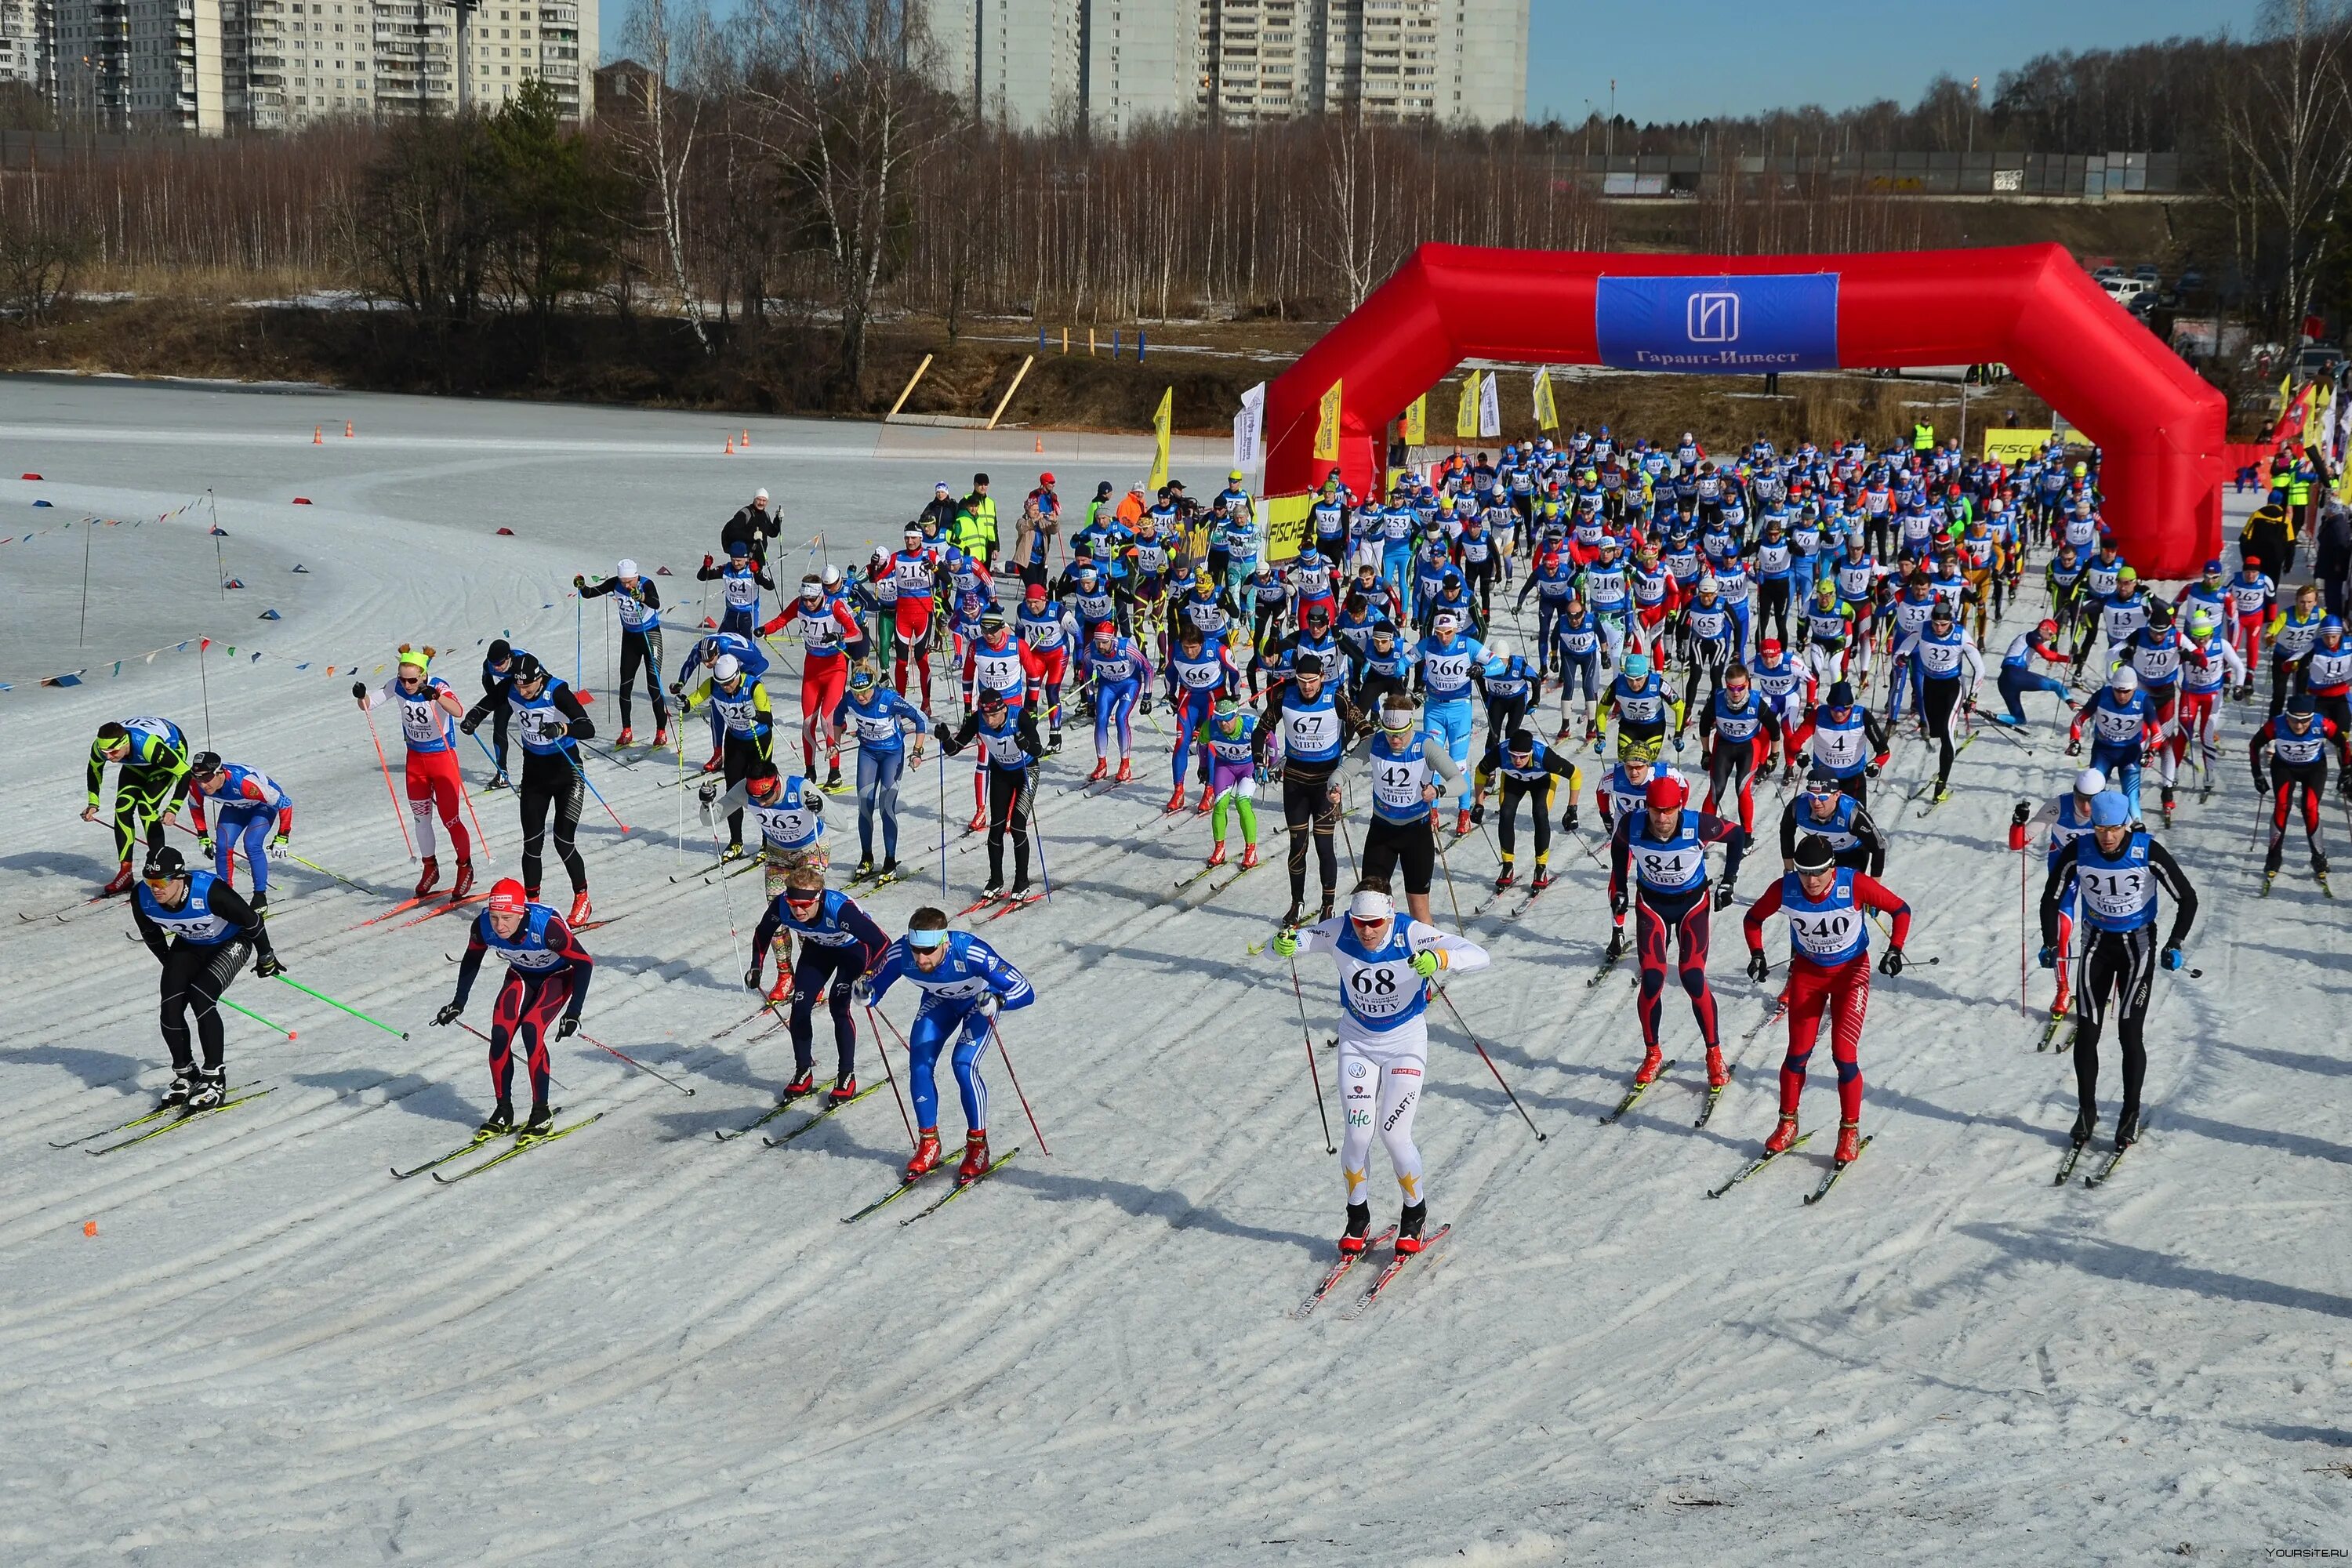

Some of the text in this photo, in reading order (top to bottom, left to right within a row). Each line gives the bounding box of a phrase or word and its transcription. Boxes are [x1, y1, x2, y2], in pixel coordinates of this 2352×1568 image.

[1636, 350, 1799, 366] Гарант-Инвест
[1987, 444, 2032, 454] FISC
[1700, 481, 1717, 490] 222
[1871, 495, 1883, 504] 99
[1322, 513, 1335, 524] 36
[1387, 517, 1406, 528] 253
[1269, 518, 1305, 543] FISCHE
[1910, 520, 1924, 530] 31
[2073, 525, 2088, 535] 46
[1711, 537, 1726, 547] 98
[1798, 533, 1810, 546] 76
[1141, 550, 1156, 562] 28
[1471, 546, 1478, 555] 3
[1769, 551, 1777, 562] 8
[1668, 557, 1692, 568] 257
[901, 565, 927, 579] 218
[1300, 572, 1320, 584] 281
[1849, 572, 1864, 583] 19
[1593, 576, 1619, 590] 216
[1719, 579, 1743, 592] 230
[2096, 574, 2114, 585] 18
[729, 582, 747, 593] 64
[879, 581, 895, 593] 73
[1081, 598, 1106, 611] 284
[1194, 607, 1221, 619] 215
[1906, 608, 1925, 621] 33
[2114, 612, 2132, 625] 13
[800, 619, 828, 635] 271
[1697, 617, 1716, 629] 65
[1812, 619, 1838, 630] 247
[2285, 629, 2316, 641] 225
[1569, 637, 1587, 647] 40
[1929, 647, 1951, 662] 32
[2146, 652, 2168, 666] 70
[985, 661, 1008, 676] 43
[1098, 662, 1126, 675] 234
[1185, 667, 1210, 680] 66
[1429, 659, 1464, 676] 266
[1436, 681, 1459, 690] МВТУ
[1628, 702, 1650, 713] 55
[403, 705, 428, 724] 38
[519, 710, 543, 728] 87
[1294, 717, 1323, 734] 67
[2100, 714, 2136, 731] 232
[408, 729, 432, 739] МВТУ
[525, 735, 549, 743] МВТ
[997, 742, 1007, 755] 7
[1295, 740, 1325, 750] МВТУ
[1832, 735, 1846, 752] 4
[1381, 767, 1410, 787] 42
[1382, 793, 1414, 804] МВТУ
[756, 813, 802, 829] 263
[146, 862, 161, 872] DNB
[1644, 855, 1683, 873] 84
[1648, 873, 1686, 884] МВТУ
[2085, 873, 2140, 896] 213
[2097, 902, 2134, 913] МВТУ
[1792, 916, 1849, 938] 240
[1806, 943, 1844, 953] МВТУ
[1351, 967, 1396, 996] 68
[1354, 999, 1399, 1014] МВТУ
[1348, 1109, 1372, 1128] life
[1383, 1097, 1410, 1131] CRAFT
